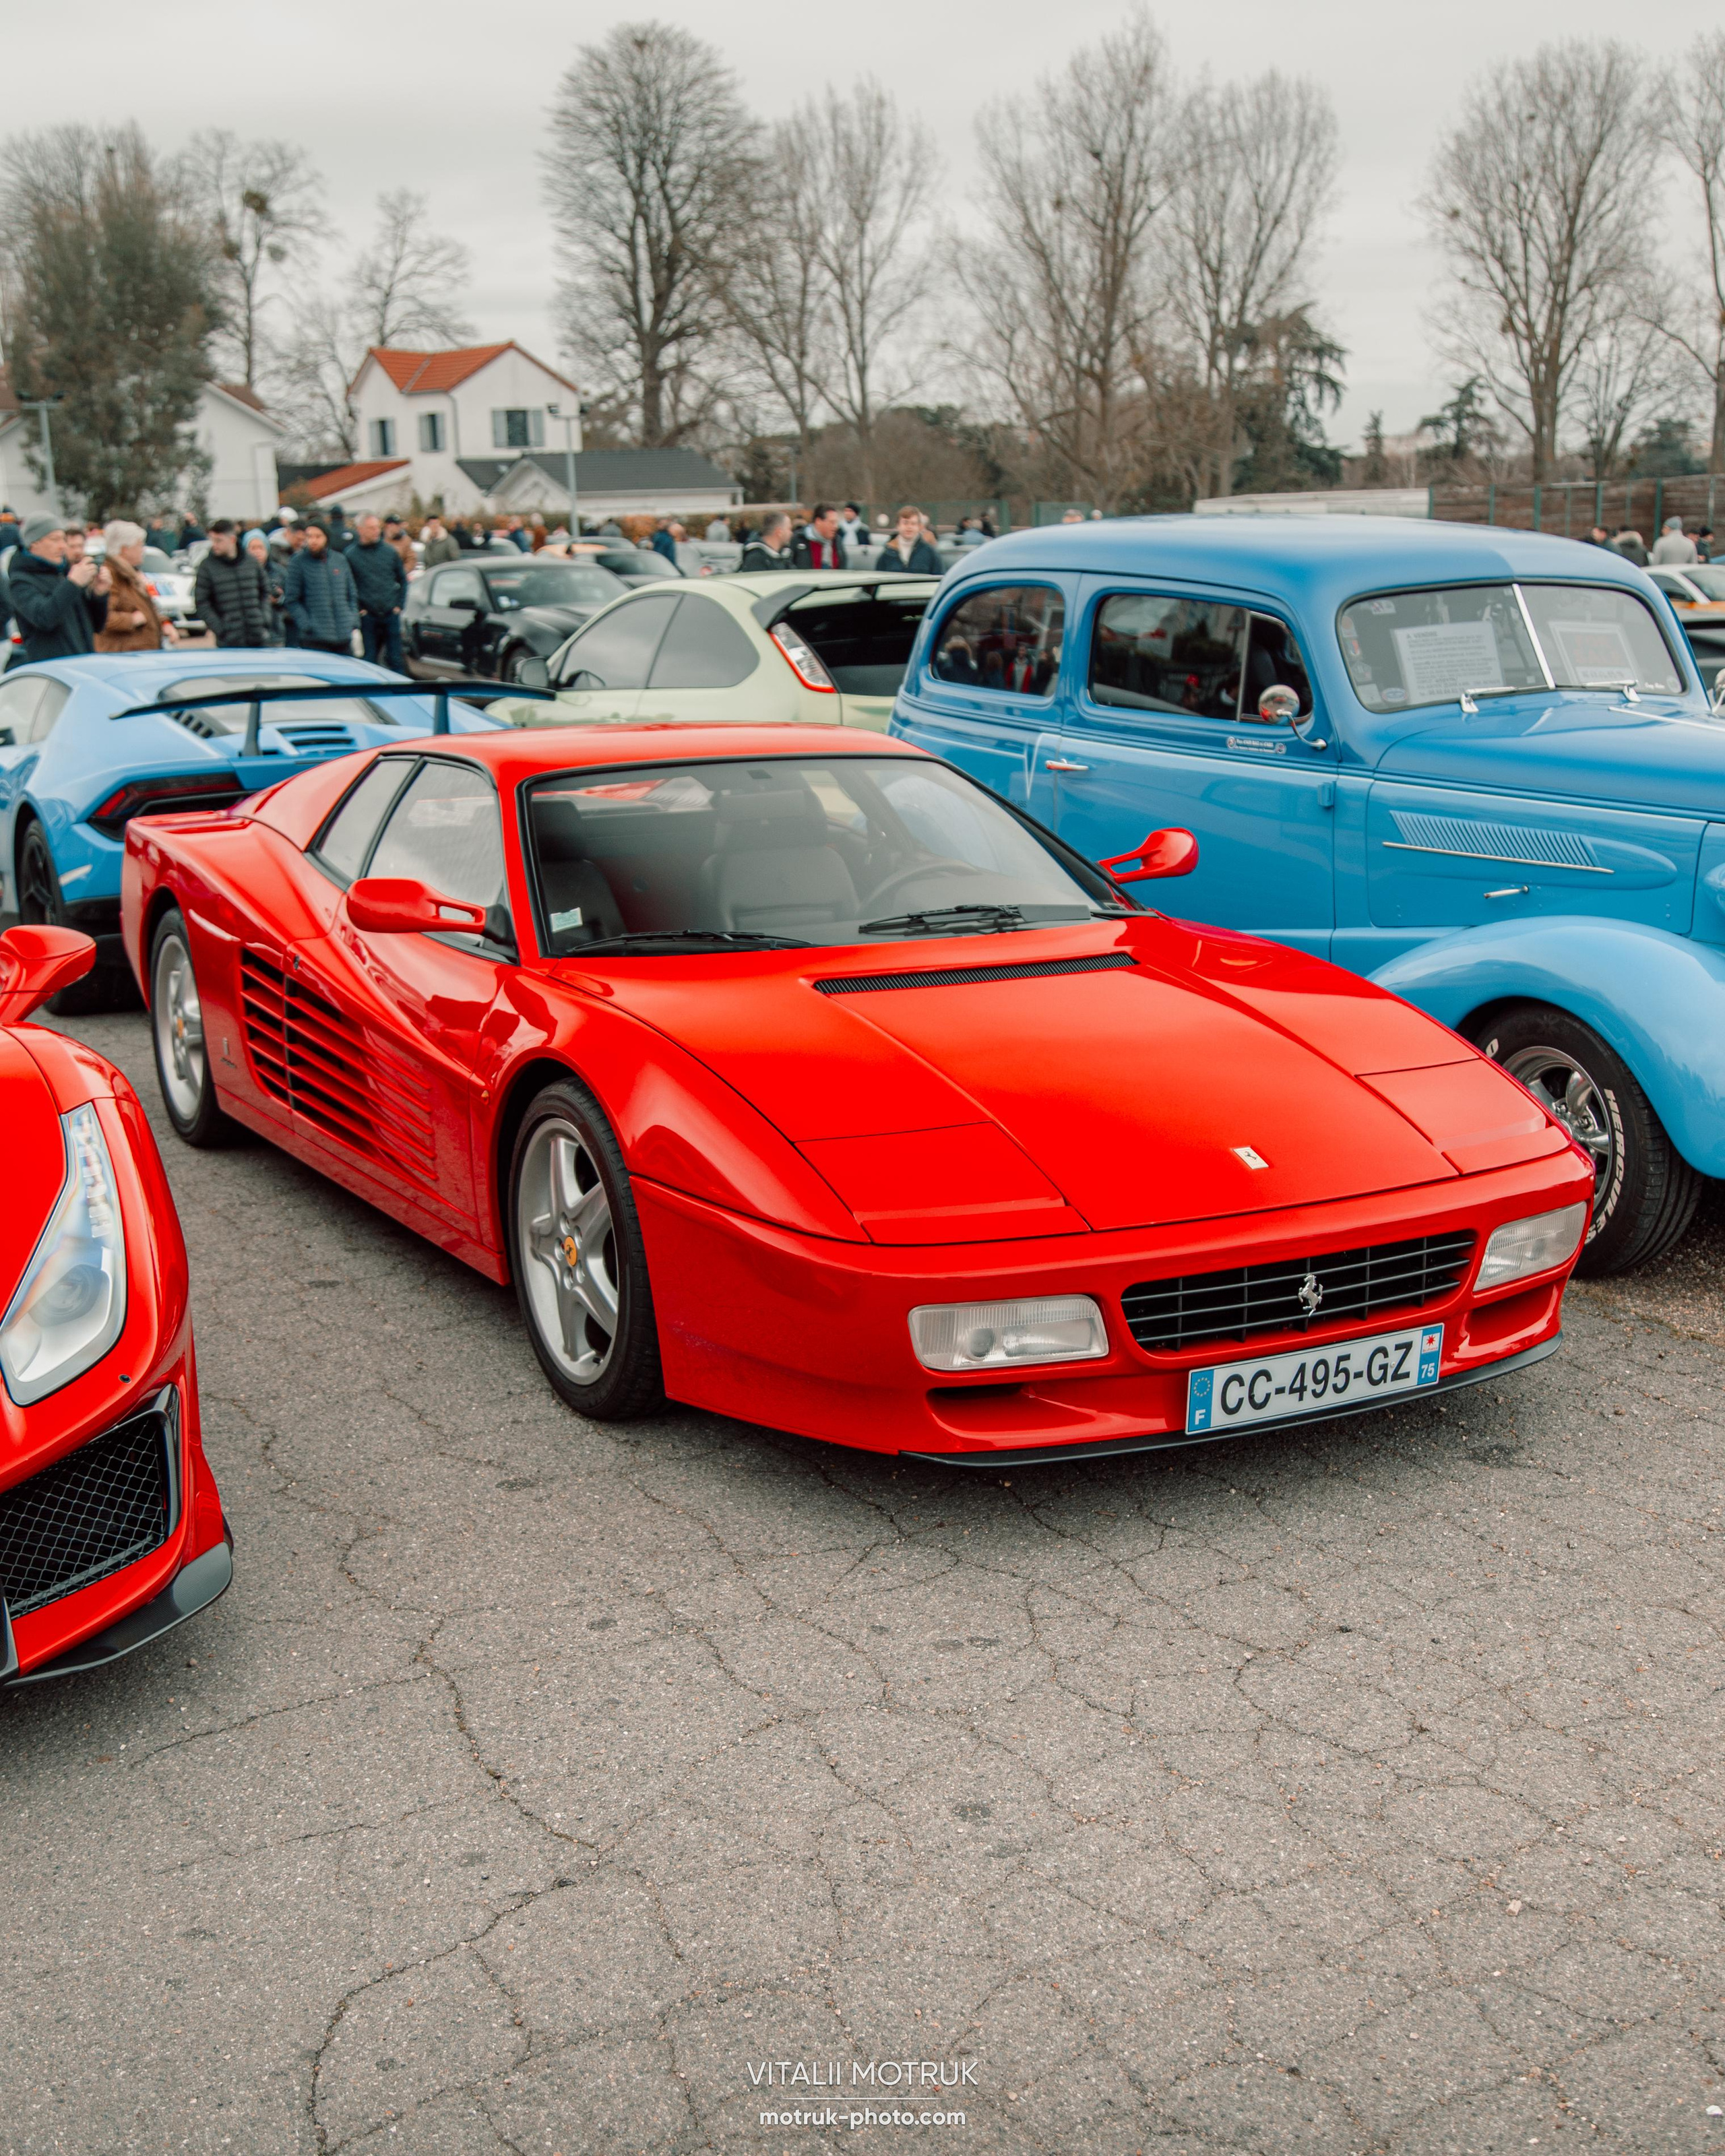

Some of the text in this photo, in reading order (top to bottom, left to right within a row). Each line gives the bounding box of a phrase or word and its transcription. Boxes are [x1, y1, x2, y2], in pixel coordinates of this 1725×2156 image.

[1584, 1088, 1625, 1245] HERCULES
[1194, 1341, 1435, 1426] F CC-495-GZ 75
